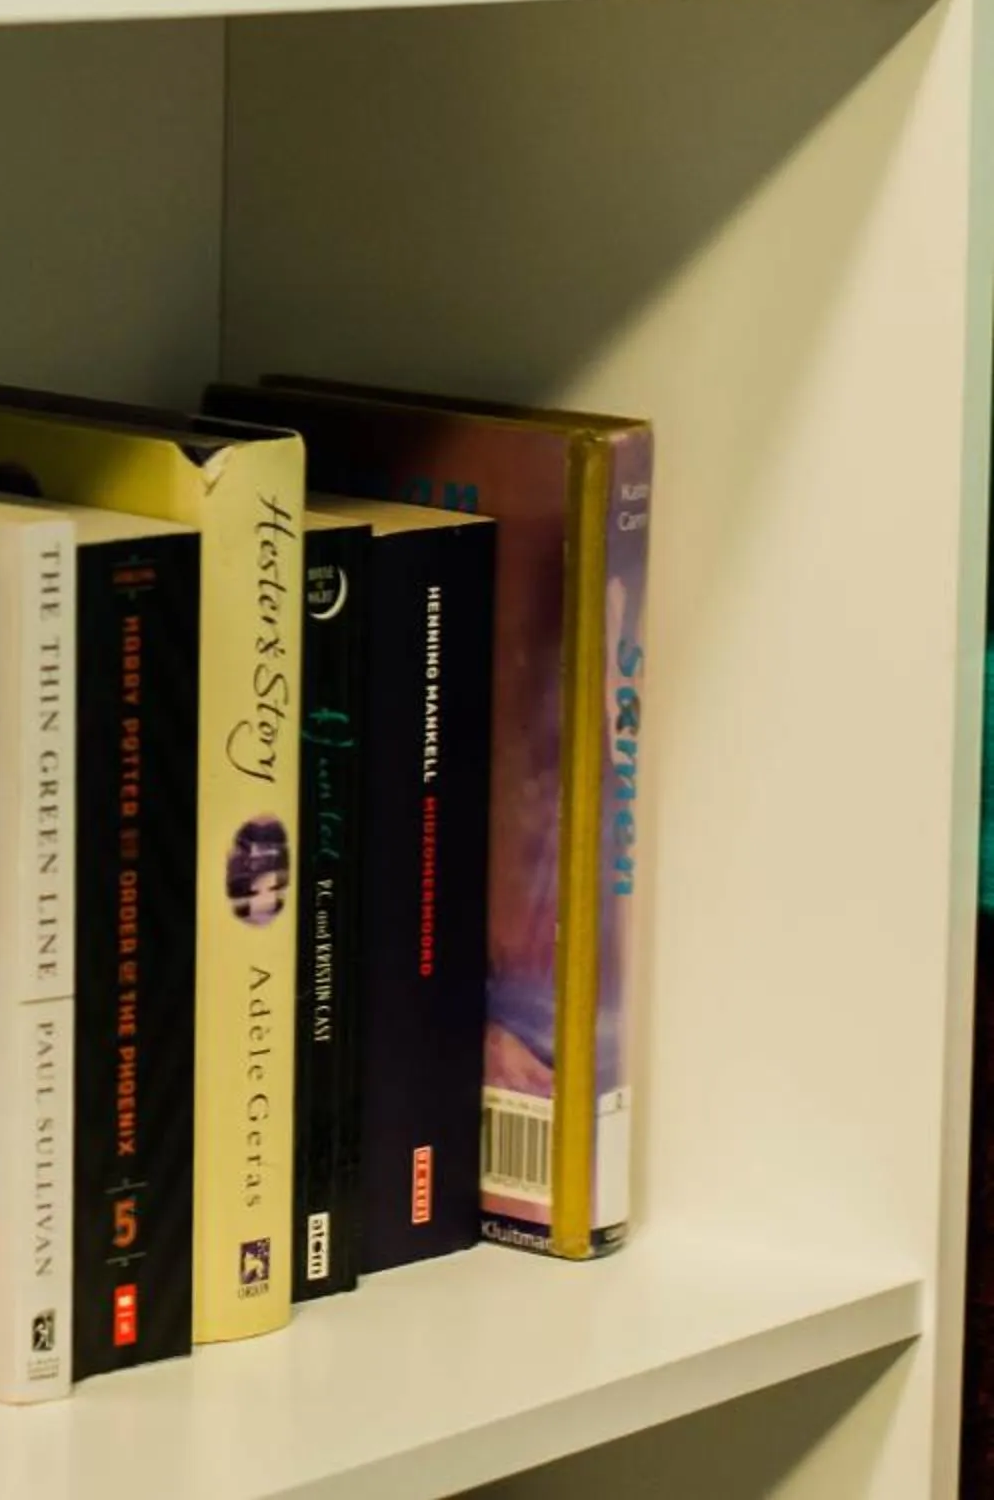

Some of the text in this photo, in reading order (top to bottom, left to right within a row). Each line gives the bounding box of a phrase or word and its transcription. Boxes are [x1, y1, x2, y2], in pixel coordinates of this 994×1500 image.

[120, 615, 142, 706] HARRY
[224, 493, 297, 784] Hester's Story
[423, 586, 442, 784] HENNING MANKELL
[37, 542, 62, 981] THE THIN GREEN LINE
[119, 716, 142, 817] POTTER
[611, 637, 644, 896] Samen
[118, 870, 139, 954] ORDER
[316, 910, 332, 938] and
[419, 797, 438, 977] MIDZOMERMOORD
[117, 989, 138, 1036] THE
[314, 942, 333, 1004] KRISTIN
[313, 1007, 332, 1043] CAST
[116, 1044, 138, 1157] PHOENIX
[245, 963, 272, 1210] Adèle Geras
[34, 1021, 55, 1279] PAUL SULLIVAN
[112, 1199, 138, 1248] 5
[308, 1218, 325, 1278] atom
